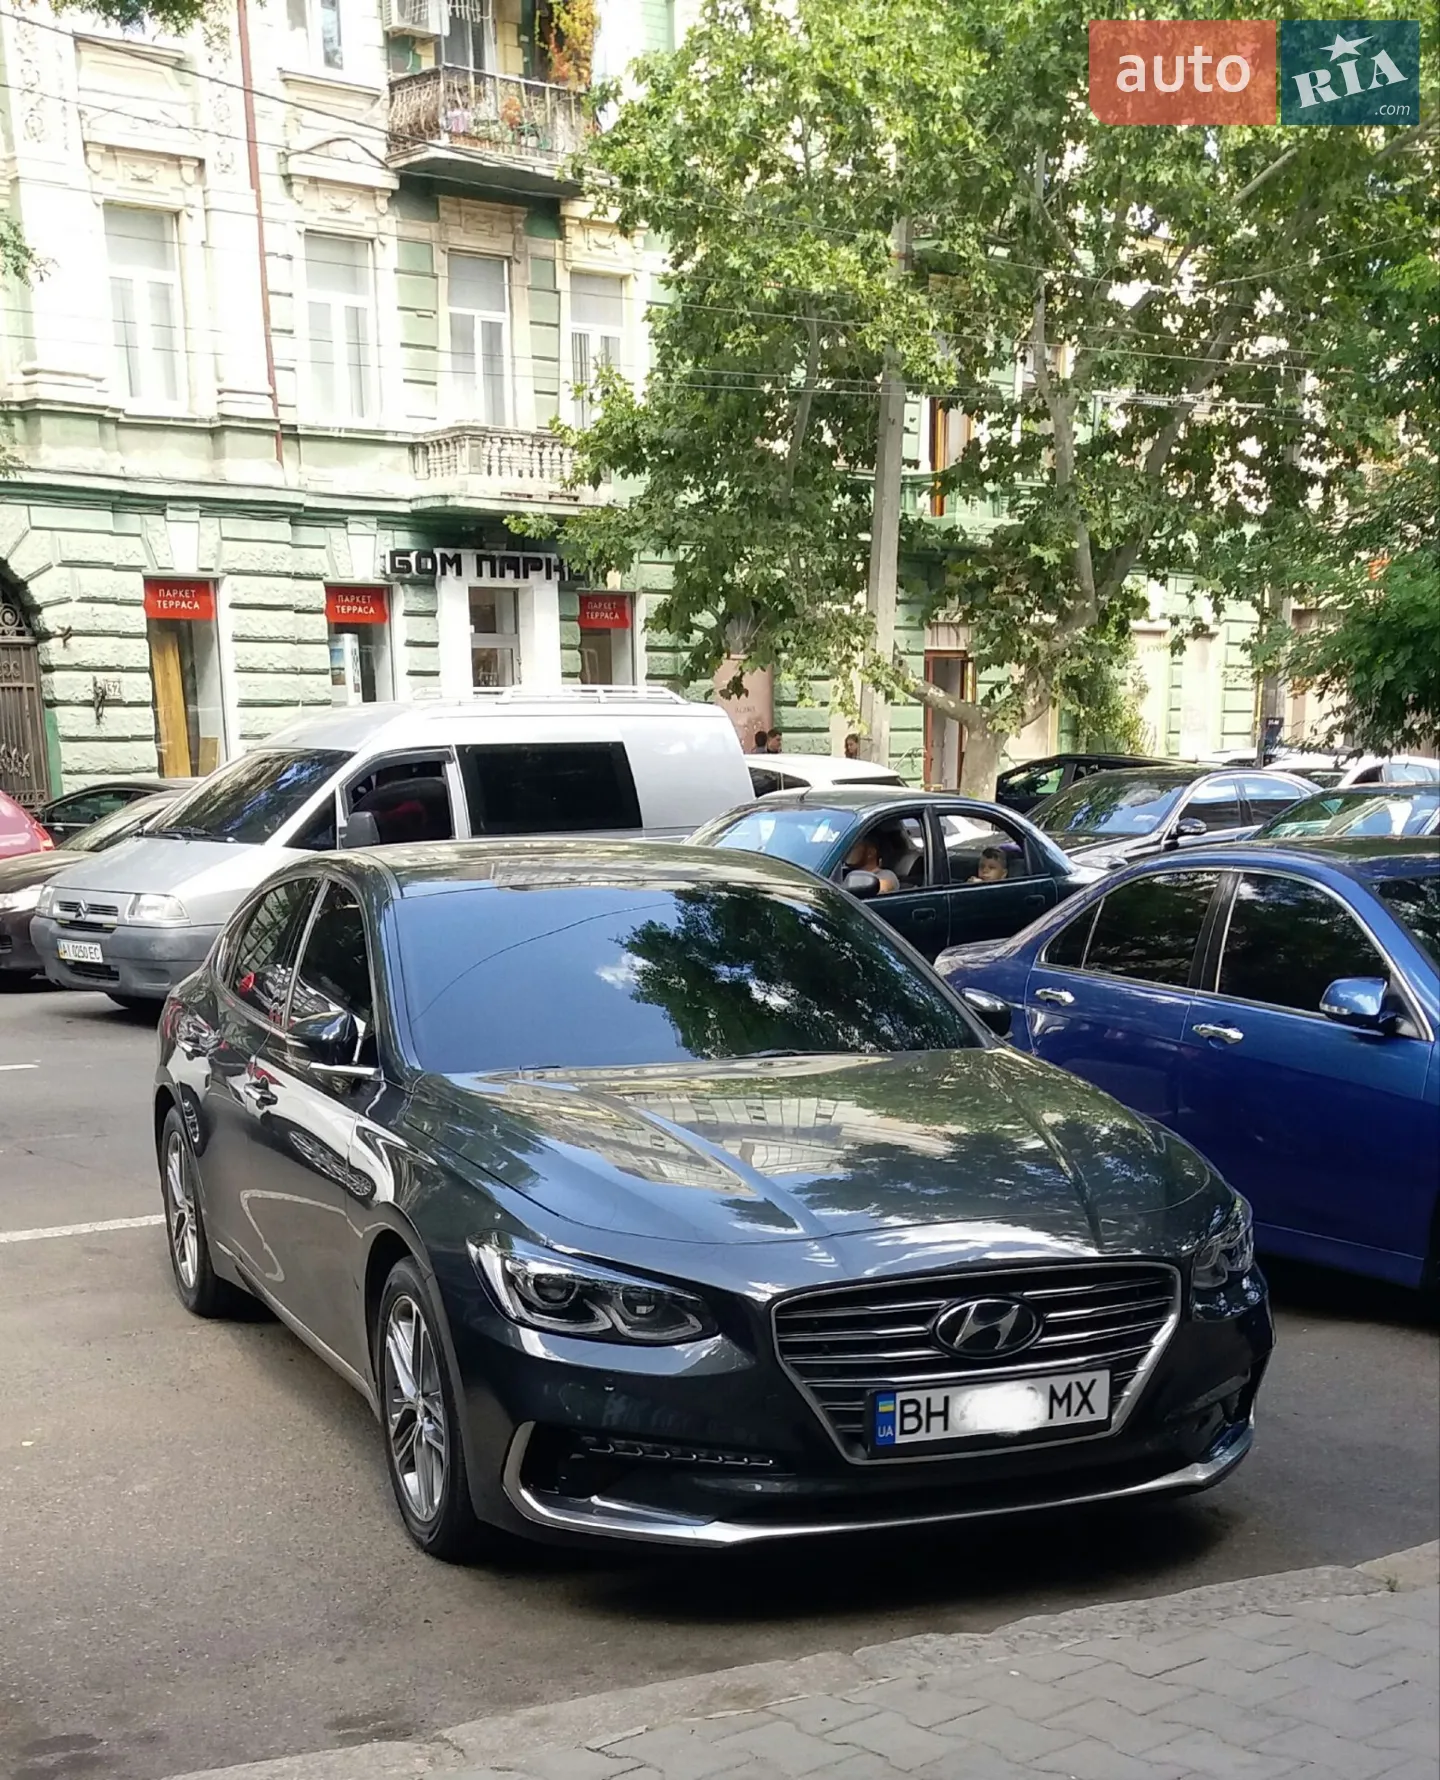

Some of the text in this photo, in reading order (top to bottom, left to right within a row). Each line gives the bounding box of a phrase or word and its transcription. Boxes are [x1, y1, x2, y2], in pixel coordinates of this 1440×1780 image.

[158, 588, 196, 598] ПАРКЕТ
[338, 594, 372, 604] ПАРКЕТ
[156, 600, 200, 610] ТЕРРАСА
[335, 605, 376, 615] ТЕРРАСА
[587, 601, 617, 610] ПАРКЕТ
[585, 611, 620, 620] ТЕРРАСА
[898, 1395, 950, 1436] BH
[1047, 1378, 1098, 1420] MX
[877, 1424, 894, 1438] UA
